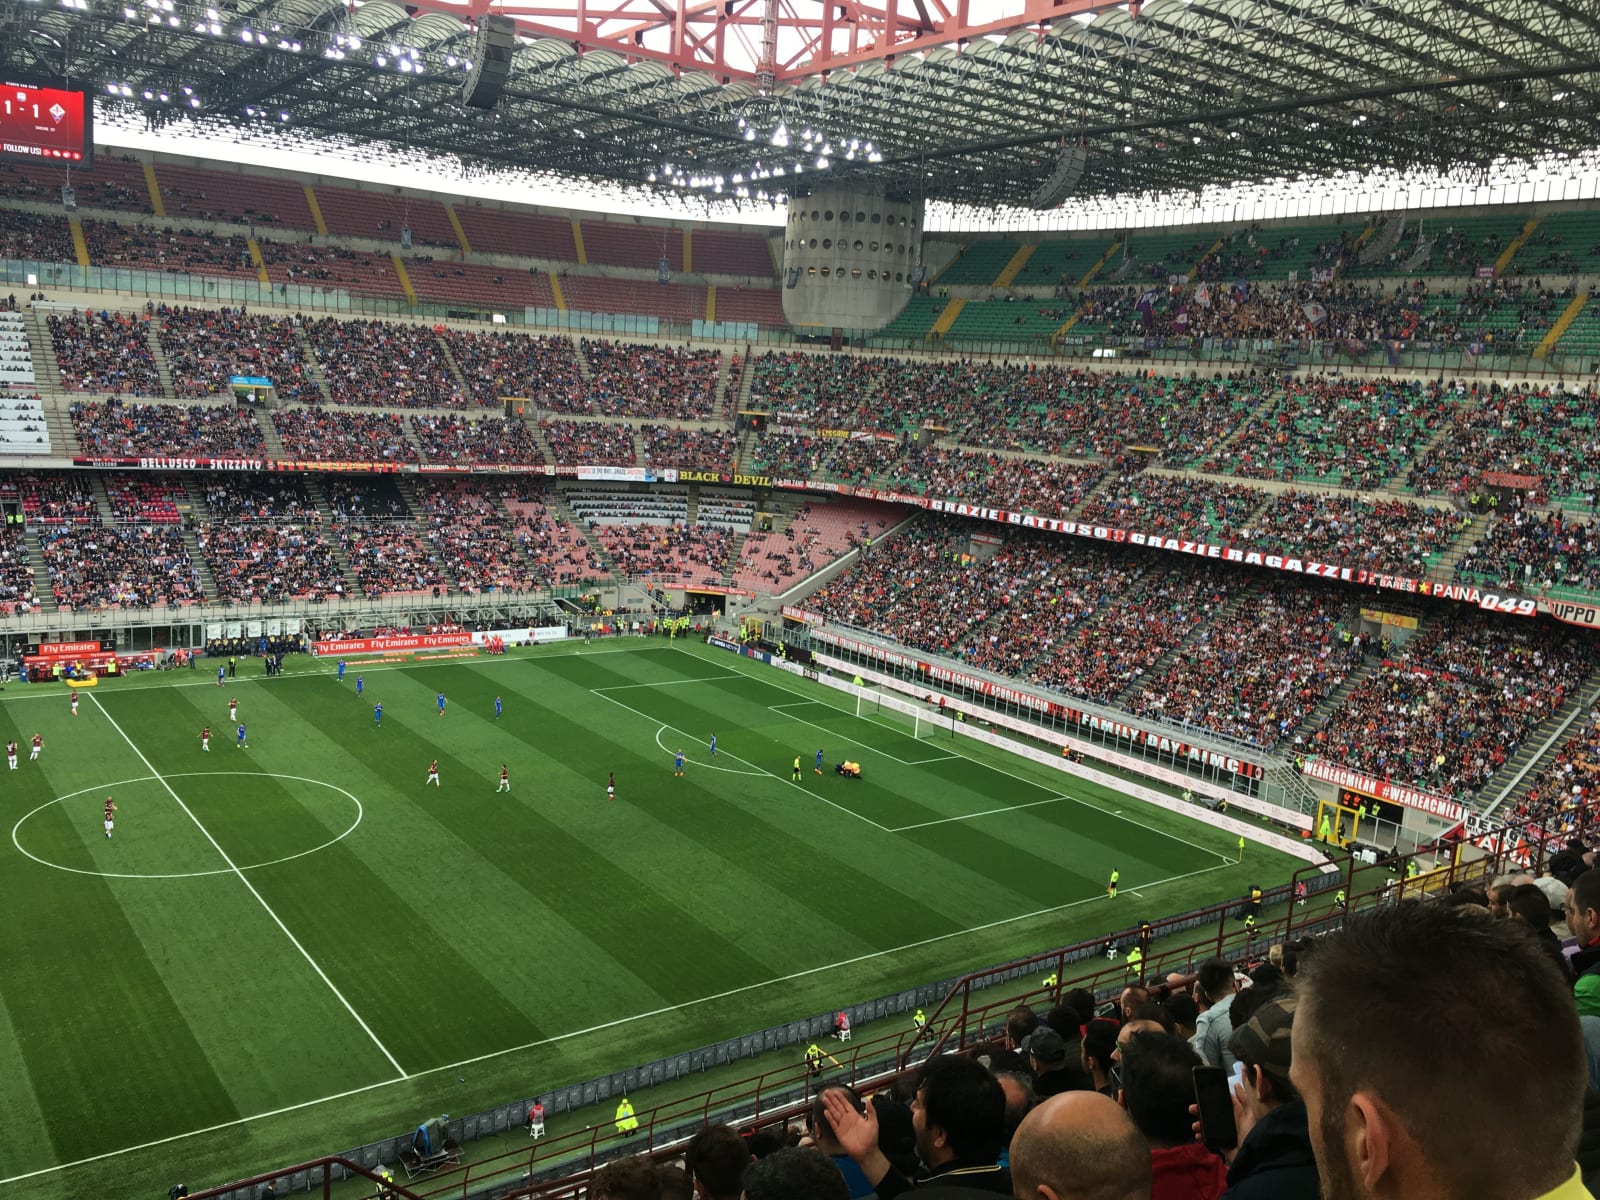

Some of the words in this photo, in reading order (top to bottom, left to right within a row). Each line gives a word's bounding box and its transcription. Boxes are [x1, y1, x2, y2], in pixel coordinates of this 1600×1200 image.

[5, 100, 11, 114] 1
[33, 104, 39, 118] 1
[4, 144, 29, 153] FOLLOW
[141, 457, 196, 469] BELLUSCO
[210, 458, 261, 469] SKIZZATO
[680, 471, 719, 482] BLACK
[734, 474, 771, 486] DEVIL
[932, 500, 999, 520] GRAZIE
[1009, 514, 1108, 539] GATTUSO
[1131, 532, 1221, 557] GRAZIE
[1228, 548, 1351, 580] RAGAZZI
[1380, 579, 1416, 592] BARESI
[1433, 584, 1481, 603] PAINA
[1480, 594, 1536, 616] 049
[44, 644, 58, 653] Fly
[60, 643, 96, 652] Emirates
[330, 641, 365, 651] Emirates
[371, 639, 384, 649] Fly
[386, 638, 418, 648] Emirates
[424, 636, 437, 646] Fly
[438, 634, 470, 645] Emirates
[753, 650, 763, 660] TIM
[930, 666, 950, 681] MILAN
[951, 672, 984, 693] ACADEMY
[991, 685, 1019, 703] SCUOLA
[1021, 694, 1049, 713] CALCIO
[1082, 713, 1140, 742] FAMILY
[1147, 733, 1181, 754] DAY
[1189, 747, 1240, 772] AIMC
[1303, 760, 1377, 794] WEAREACMILAN
[1382, 787, 1470, 821] #WEAREACMILAN
